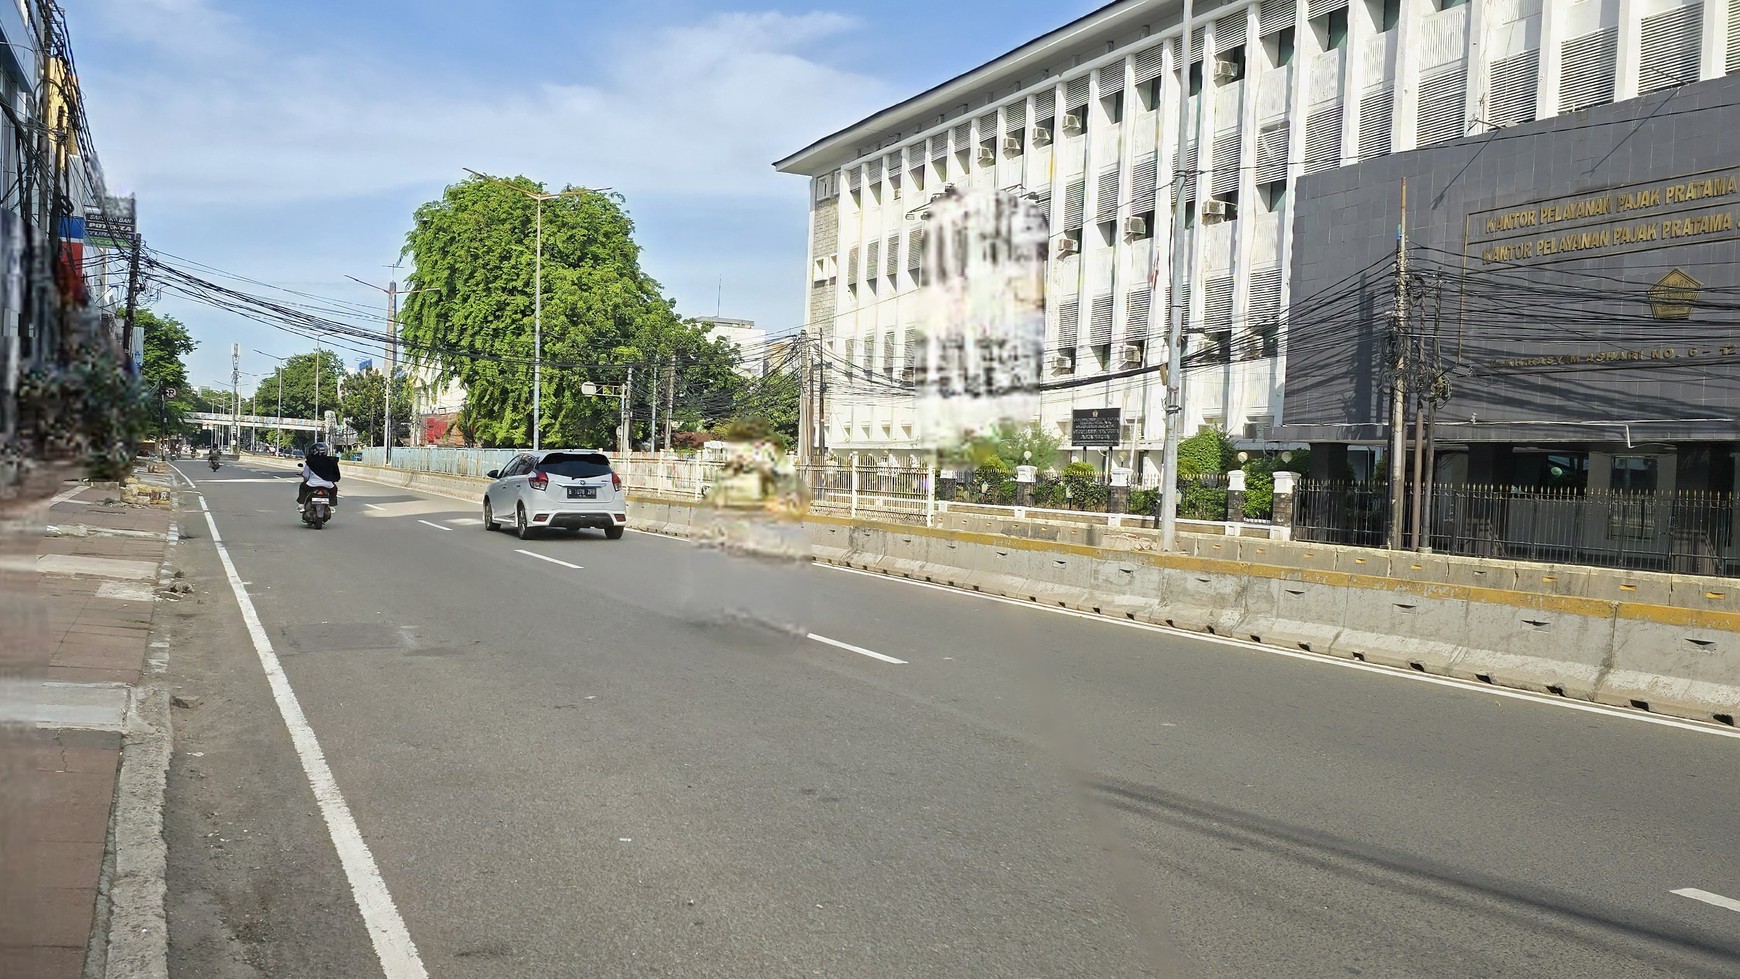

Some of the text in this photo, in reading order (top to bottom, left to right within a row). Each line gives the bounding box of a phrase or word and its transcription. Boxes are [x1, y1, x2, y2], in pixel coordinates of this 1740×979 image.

[1485, 175, 1738, 234] KANTOR PELAYANAN PAJAK PRATAMA
[1482, 241, 1532, 266] KANTOR
[1536, 230, 1610, 257] PELAYANAN
[1612, 222, 1658, 246] PAJAK
[1661, 212, 1732, 240] PRATAMA
